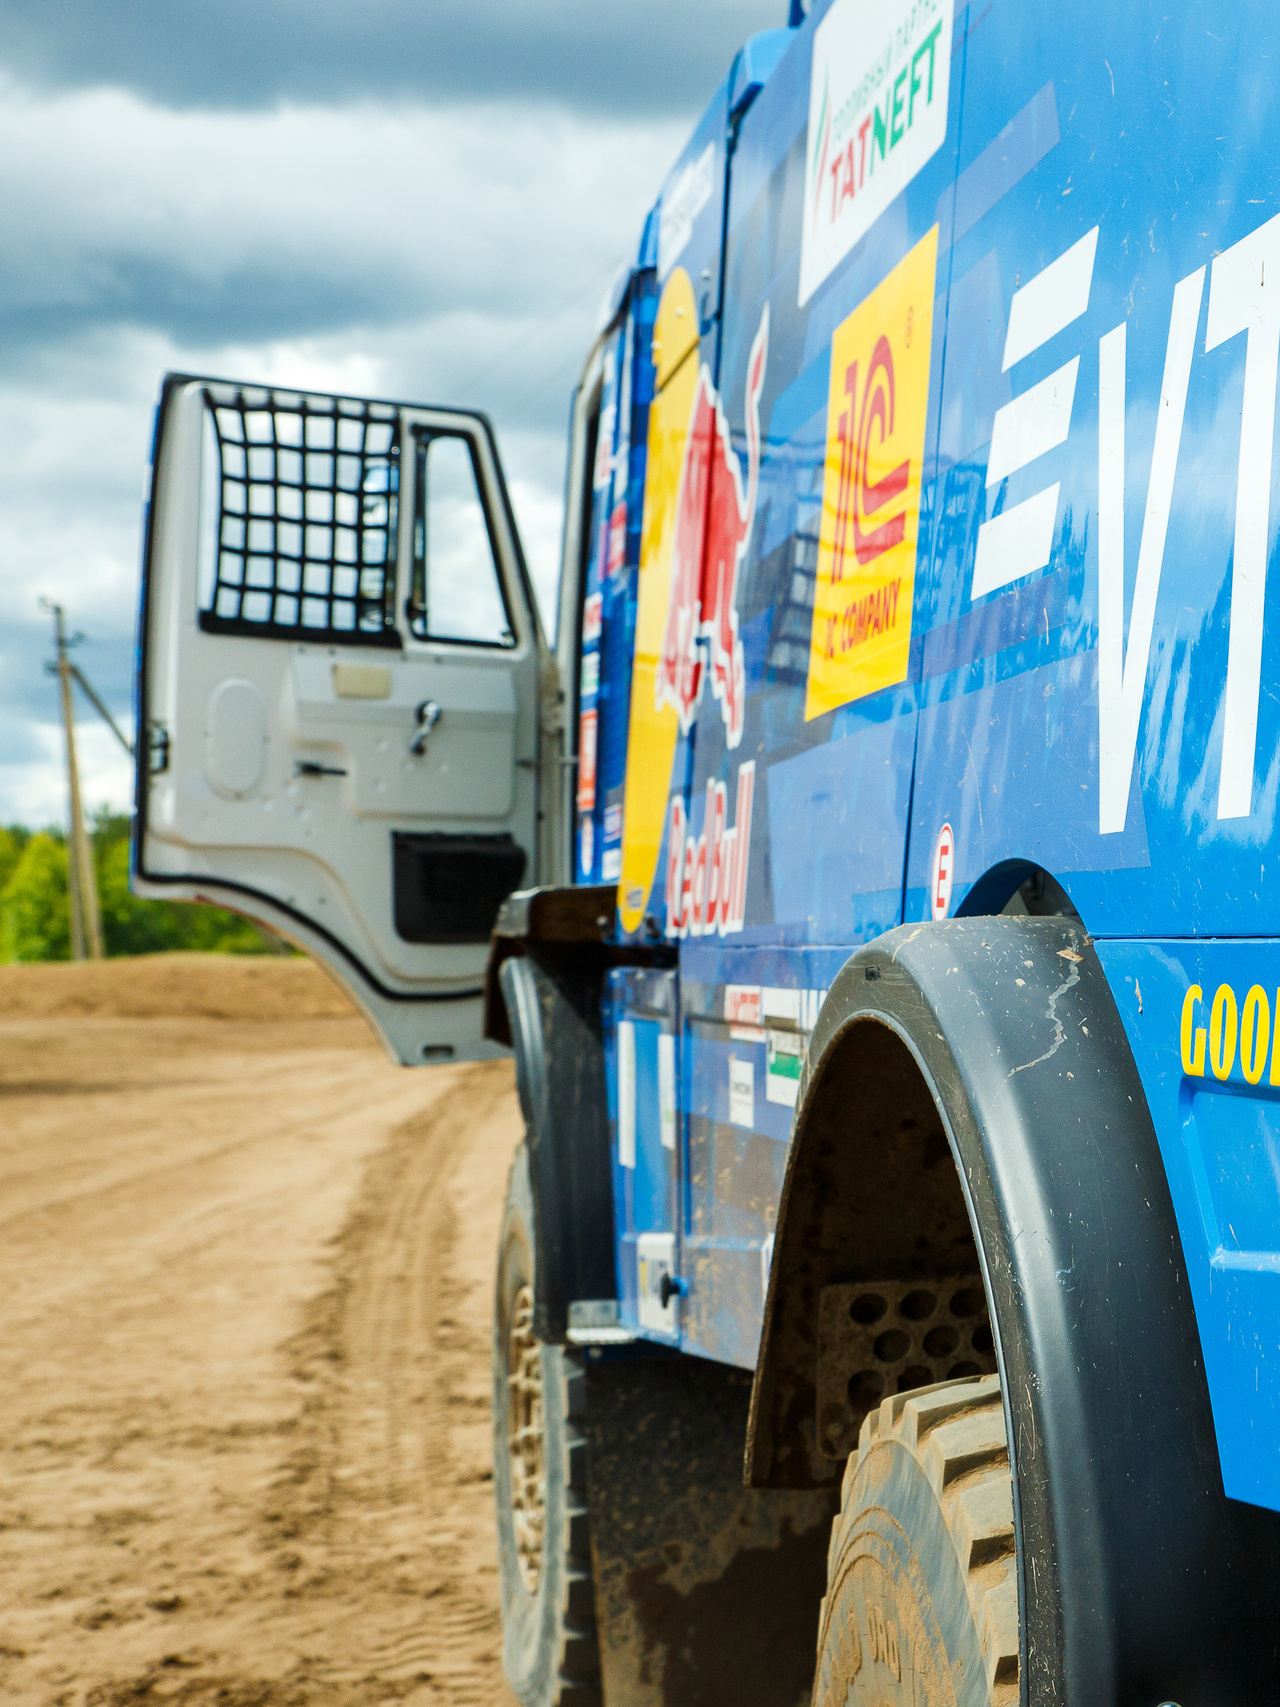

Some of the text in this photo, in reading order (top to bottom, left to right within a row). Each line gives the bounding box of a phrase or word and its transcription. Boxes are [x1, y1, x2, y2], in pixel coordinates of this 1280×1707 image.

[831, 17, 943, 224] TATNEFT
[841, 577, 901, 653] COMPANY
[936, 845, 949, 908] E
